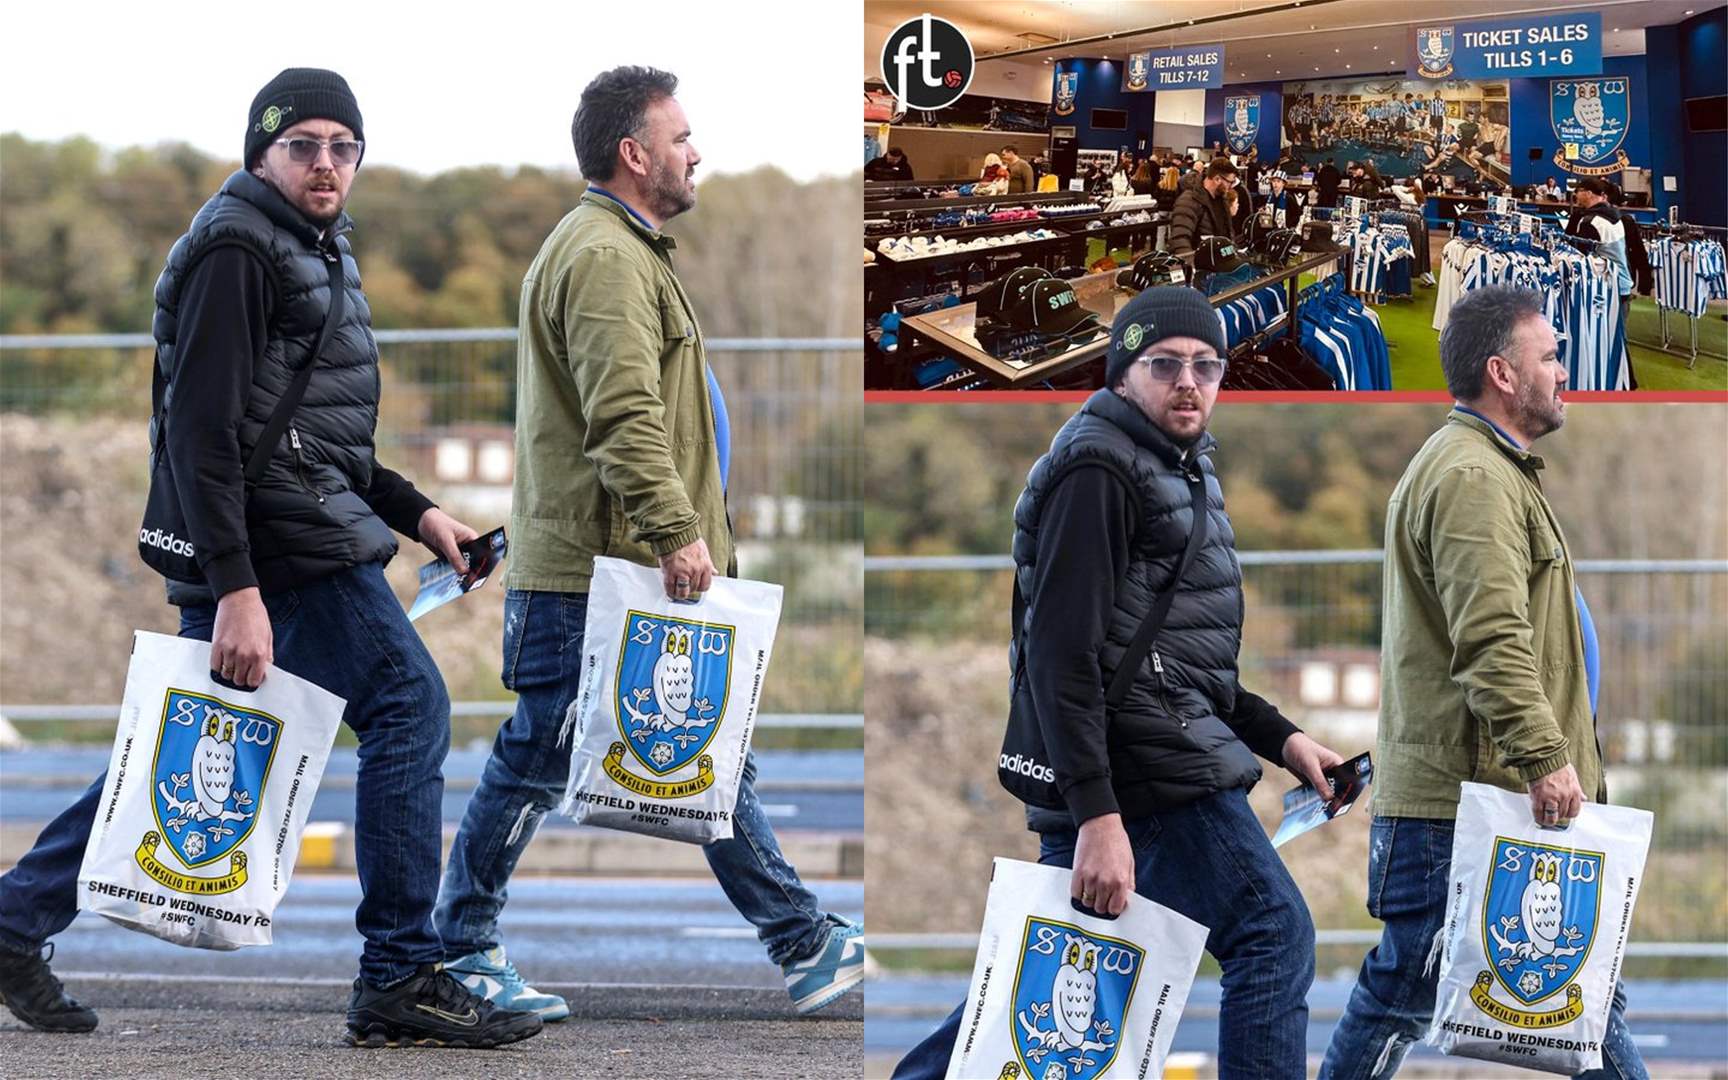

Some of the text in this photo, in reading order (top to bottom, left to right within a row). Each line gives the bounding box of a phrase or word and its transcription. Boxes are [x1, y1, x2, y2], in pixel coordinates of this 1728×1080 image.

[1462, 23, 1589, 48] TICKET SALES
[1153, 52, 1218, 69] RETAIL SALES
[1484, 50, 1533, 69] TILLS
[1160, 70, 1209, 84] TILLS 7-12
[1557, 160, 1588, 174] CONILIO
[139, 528, 195, 557] adidas
[295, 754, 309, 776] MAIL
[999, 753, 1055, 783] adidas
[105, 737, 133, 823] WWW.SWFC.CO.UK
[287, 778, 300, 808] ORDER
[609, 765, 708, 796] CONSILIO ET ANIMIS
[575, 790, 635, 811] HEFFIELD
[630, 813, 669, 826] #SWFC
[142, 857, 239, 892] CONSILIO ET ANIMIS
[88, 880, 271, 927] SHEFFIELD WEDNESDAY FC
[160, 911, 196, 926] #SWFC
[1157, 983, 1171, 1006] MAIL
[963, 965, 993, 1053] WWW.SWFC.CO.UK
[1476, 994, 1577, 1026] CONSILIO ET ANIMIS
[1149, 1008, 1162, 1038] ORDER
[1442, 1020, 1503, 1041] HEFFIELD
[1507, 1032, 1588, 1052] WEDNESDAY
[1499, 1044, 1537, 1057] #SWFC
